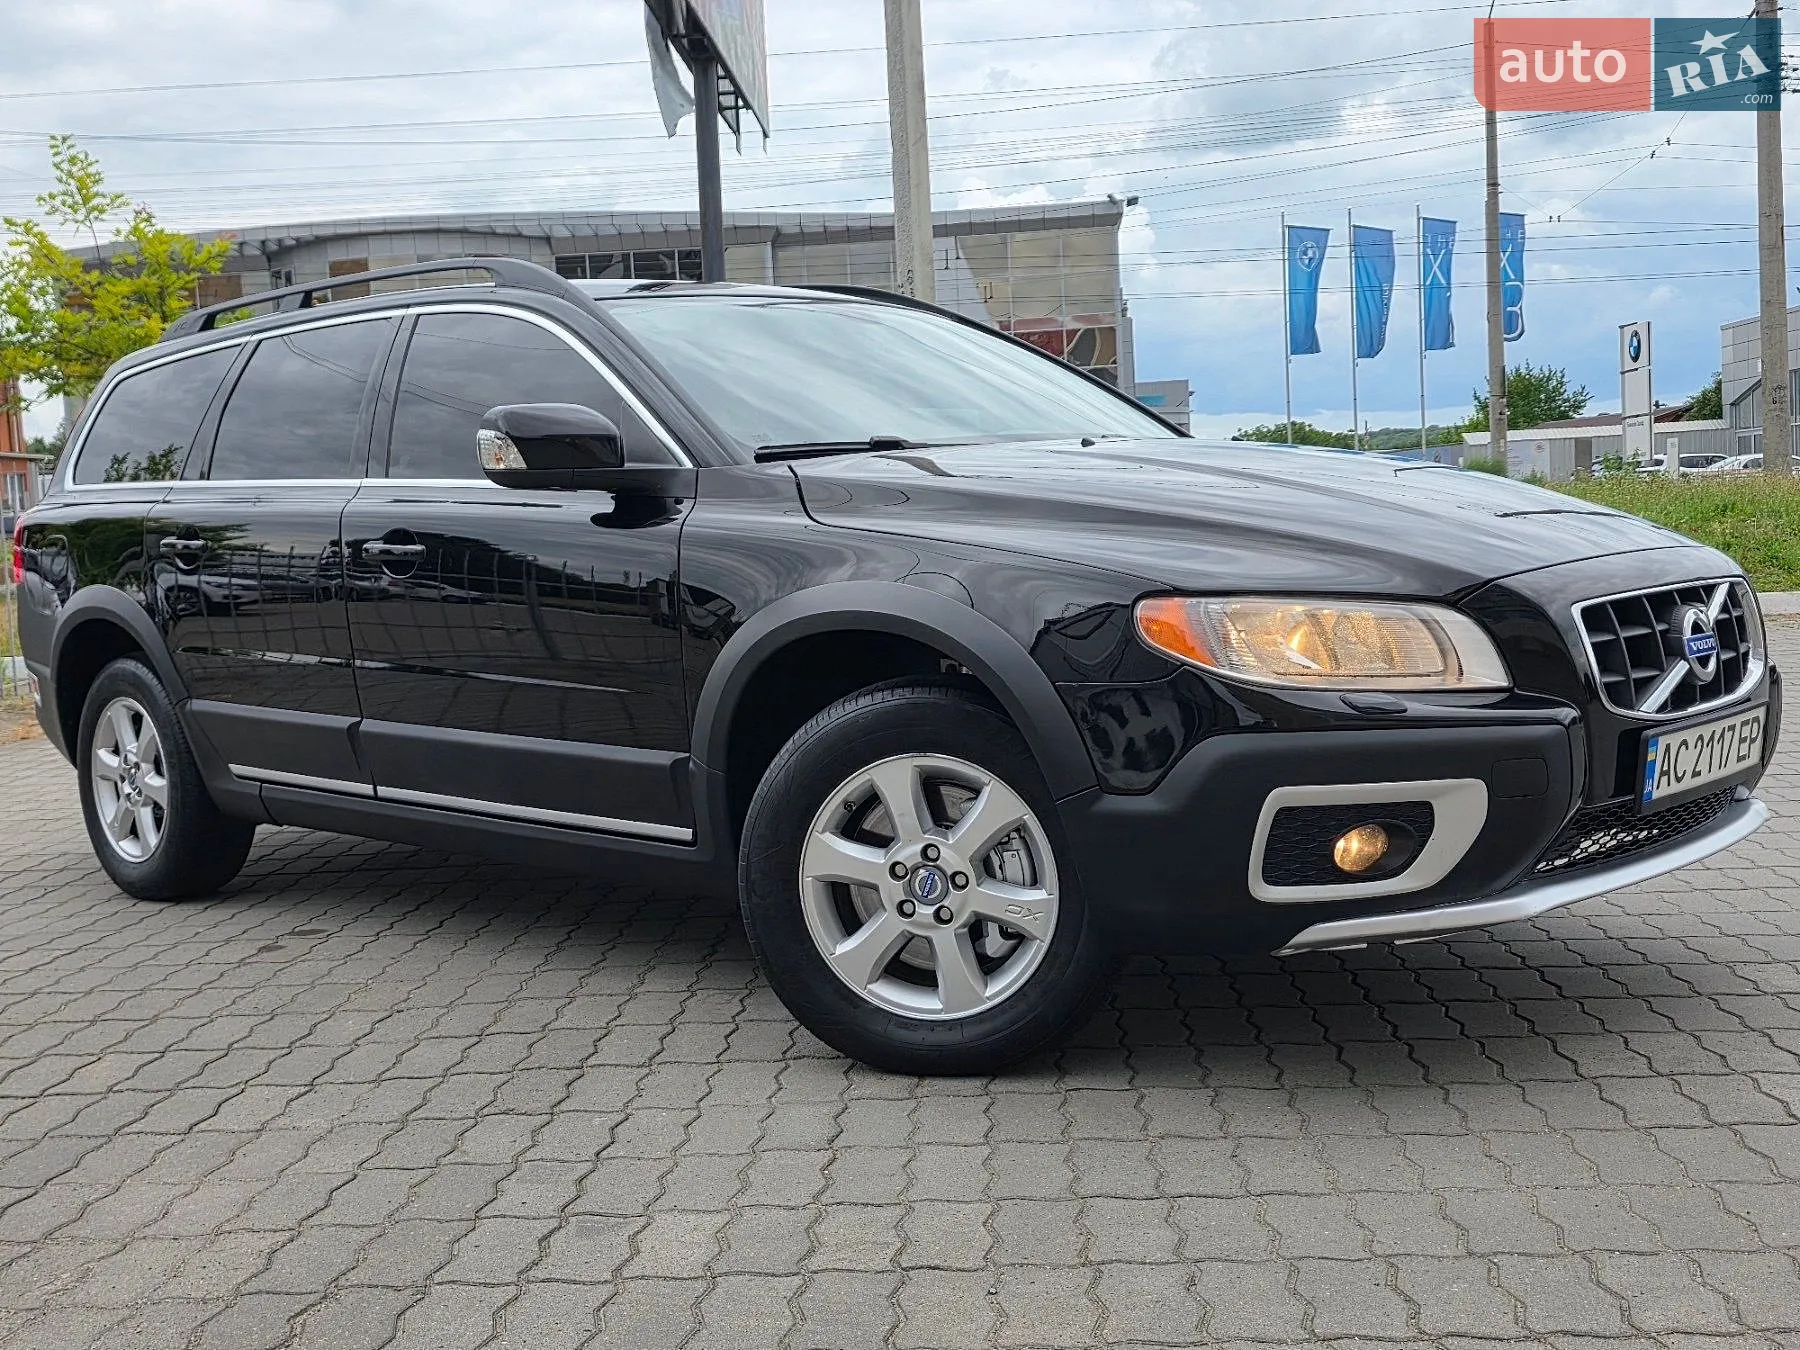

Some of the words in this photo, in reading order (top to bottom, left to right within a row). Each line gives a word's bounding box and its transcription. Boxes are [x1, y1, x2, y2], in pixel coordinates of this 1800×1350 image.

[1656, 738, 1689, 790] AC
[1691, 723, 1737, 779] 2117
[1736, 715, 1761, 764] EP
